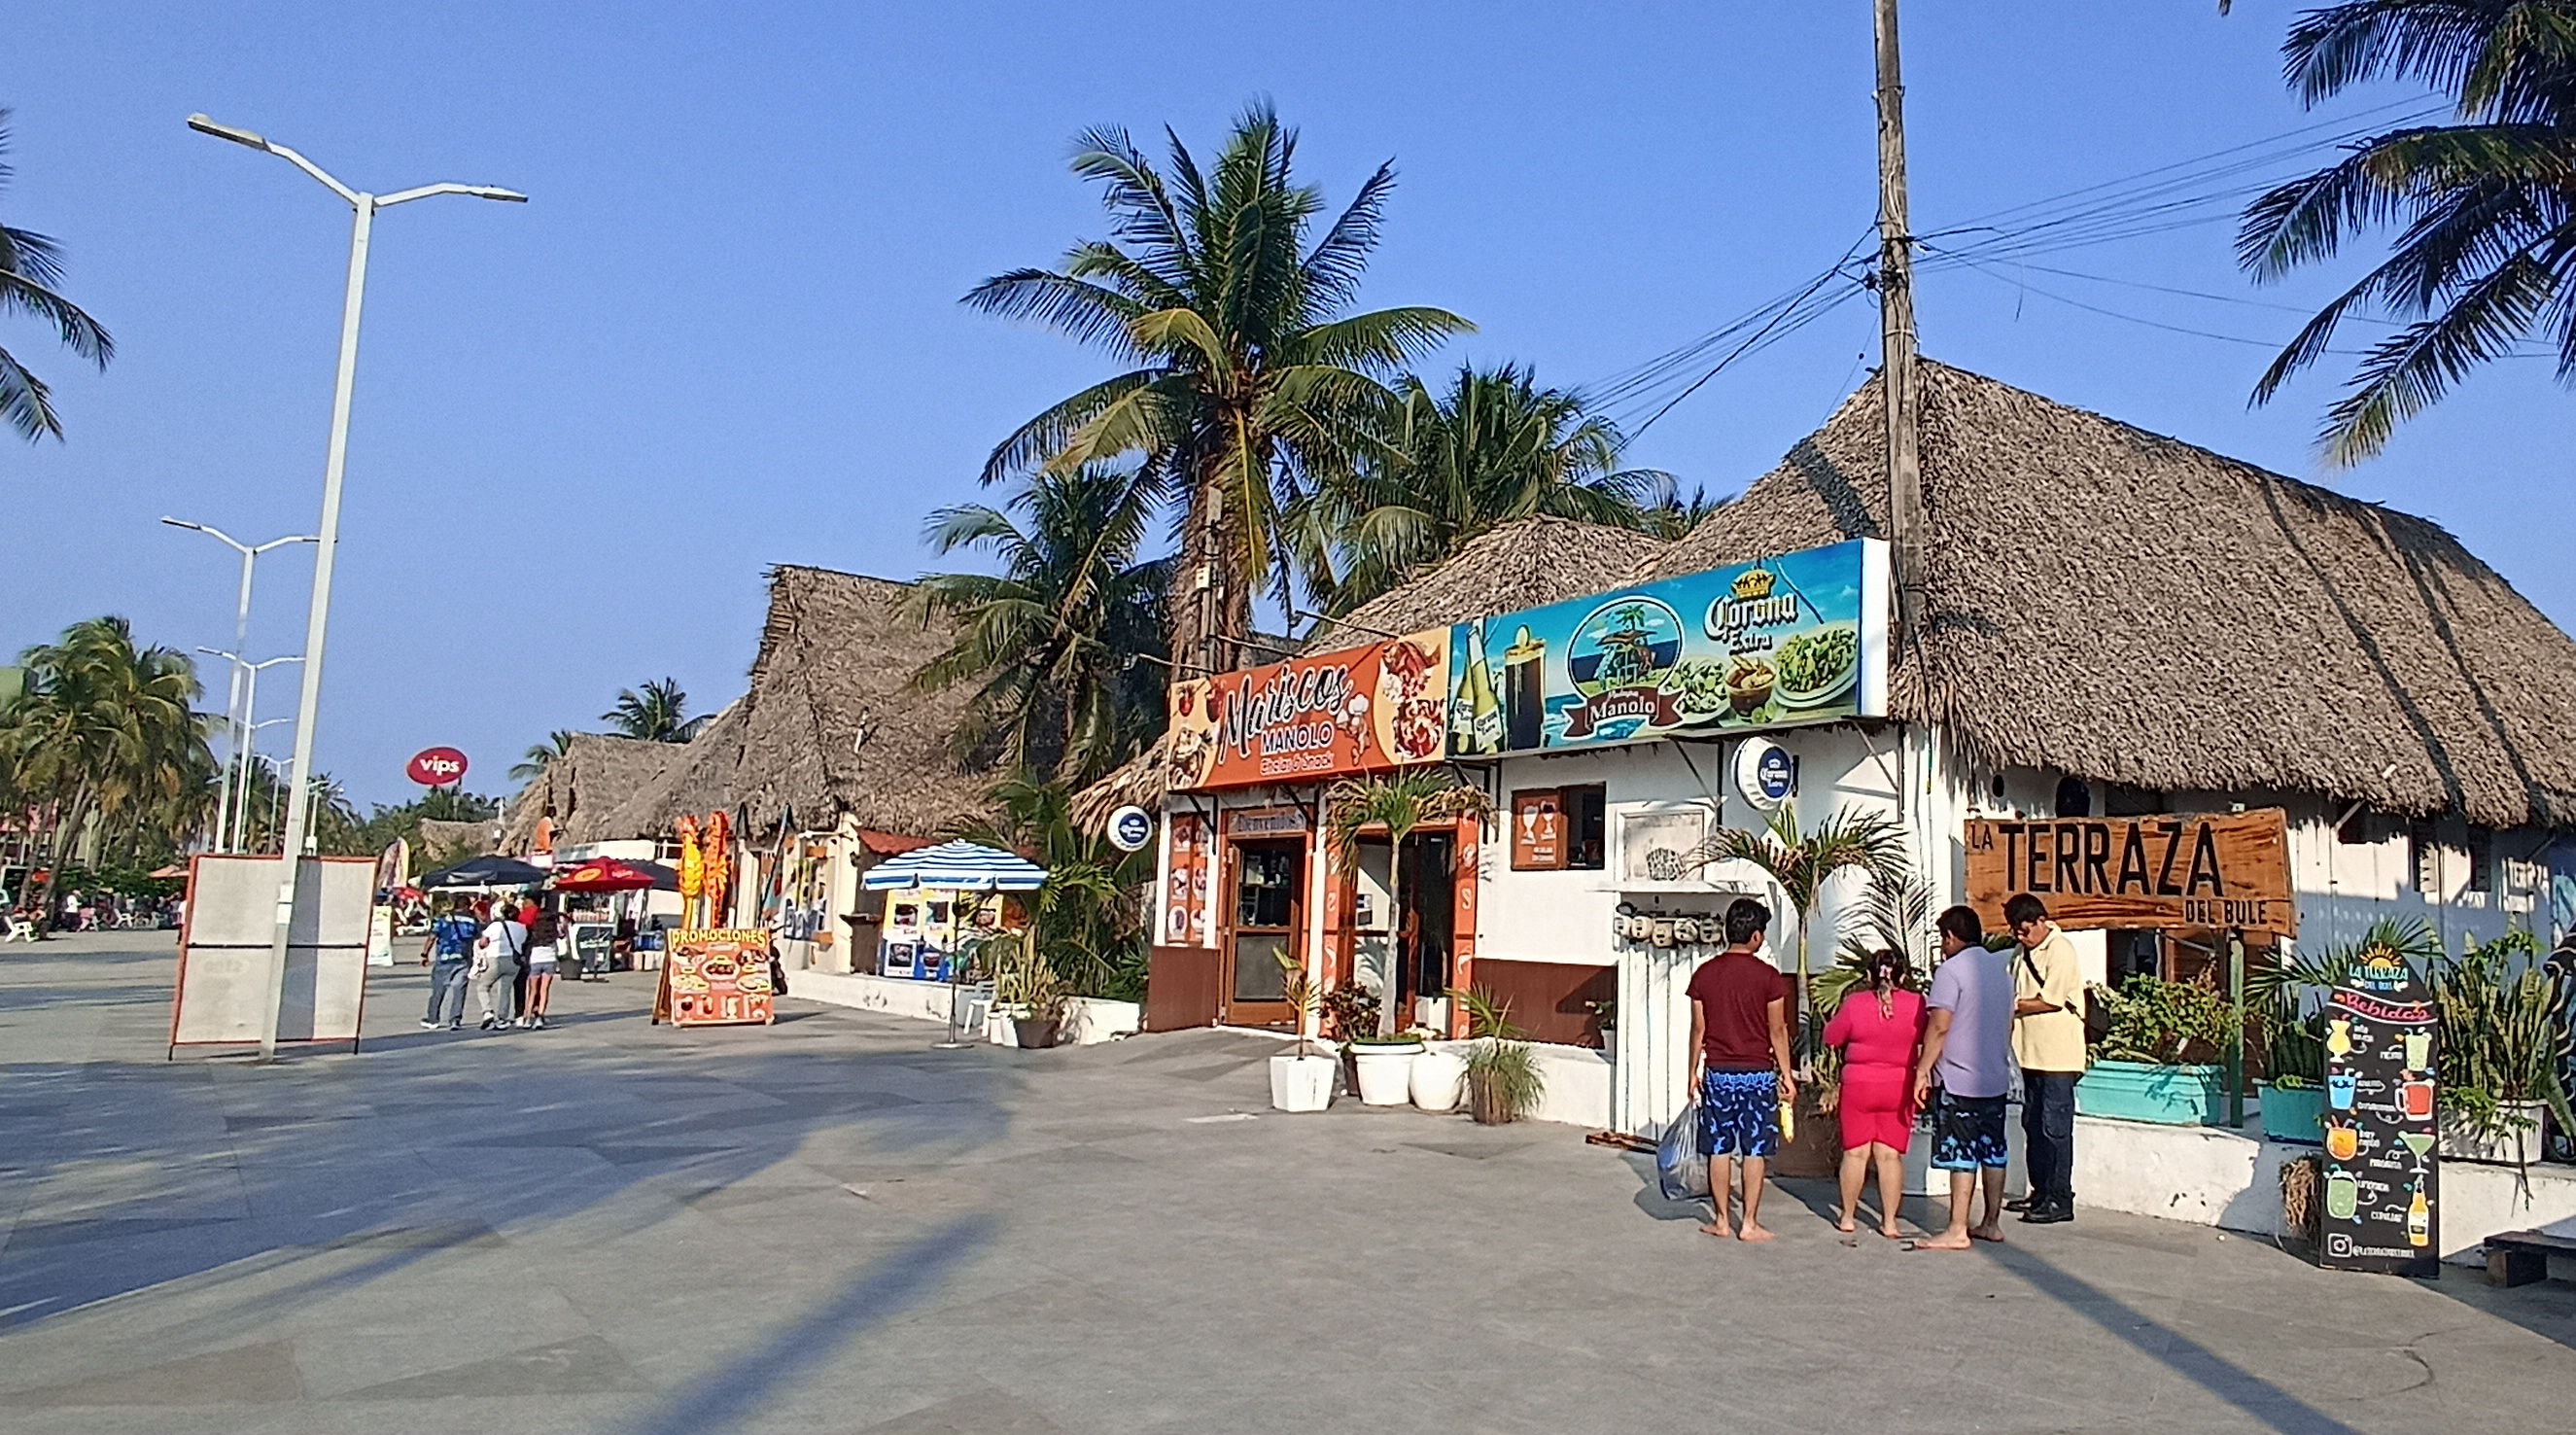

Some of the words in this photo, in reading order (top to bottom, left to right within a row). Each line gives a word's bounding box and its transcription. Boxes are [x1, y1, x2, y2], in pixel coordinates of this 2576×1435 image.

[1704, 592, 1799, 644] Corona
[1729, 629, 1773, 655] Extra
[1218, 663, 1353, 766] Mariscos
[1590, 696, 1656, 722] Manolo
[1261, 720, 1335, 755] MANOLO
[419, 754, 460, 776] vips
[1970, 823, 1994, 850] LA
[1999, 822, 2224, 897] TERRAZA
[2186, 899, 2215, 924] DEL
[2224, 899, 2267, 925] BULE
[672, 928, 766, 949] PROMOCIONES
[2349, 962, 2362, 978] LA
[2364, 966, 2408, 980] TERRAZA
[2347, 992, 2431, 1021] Bebidas
